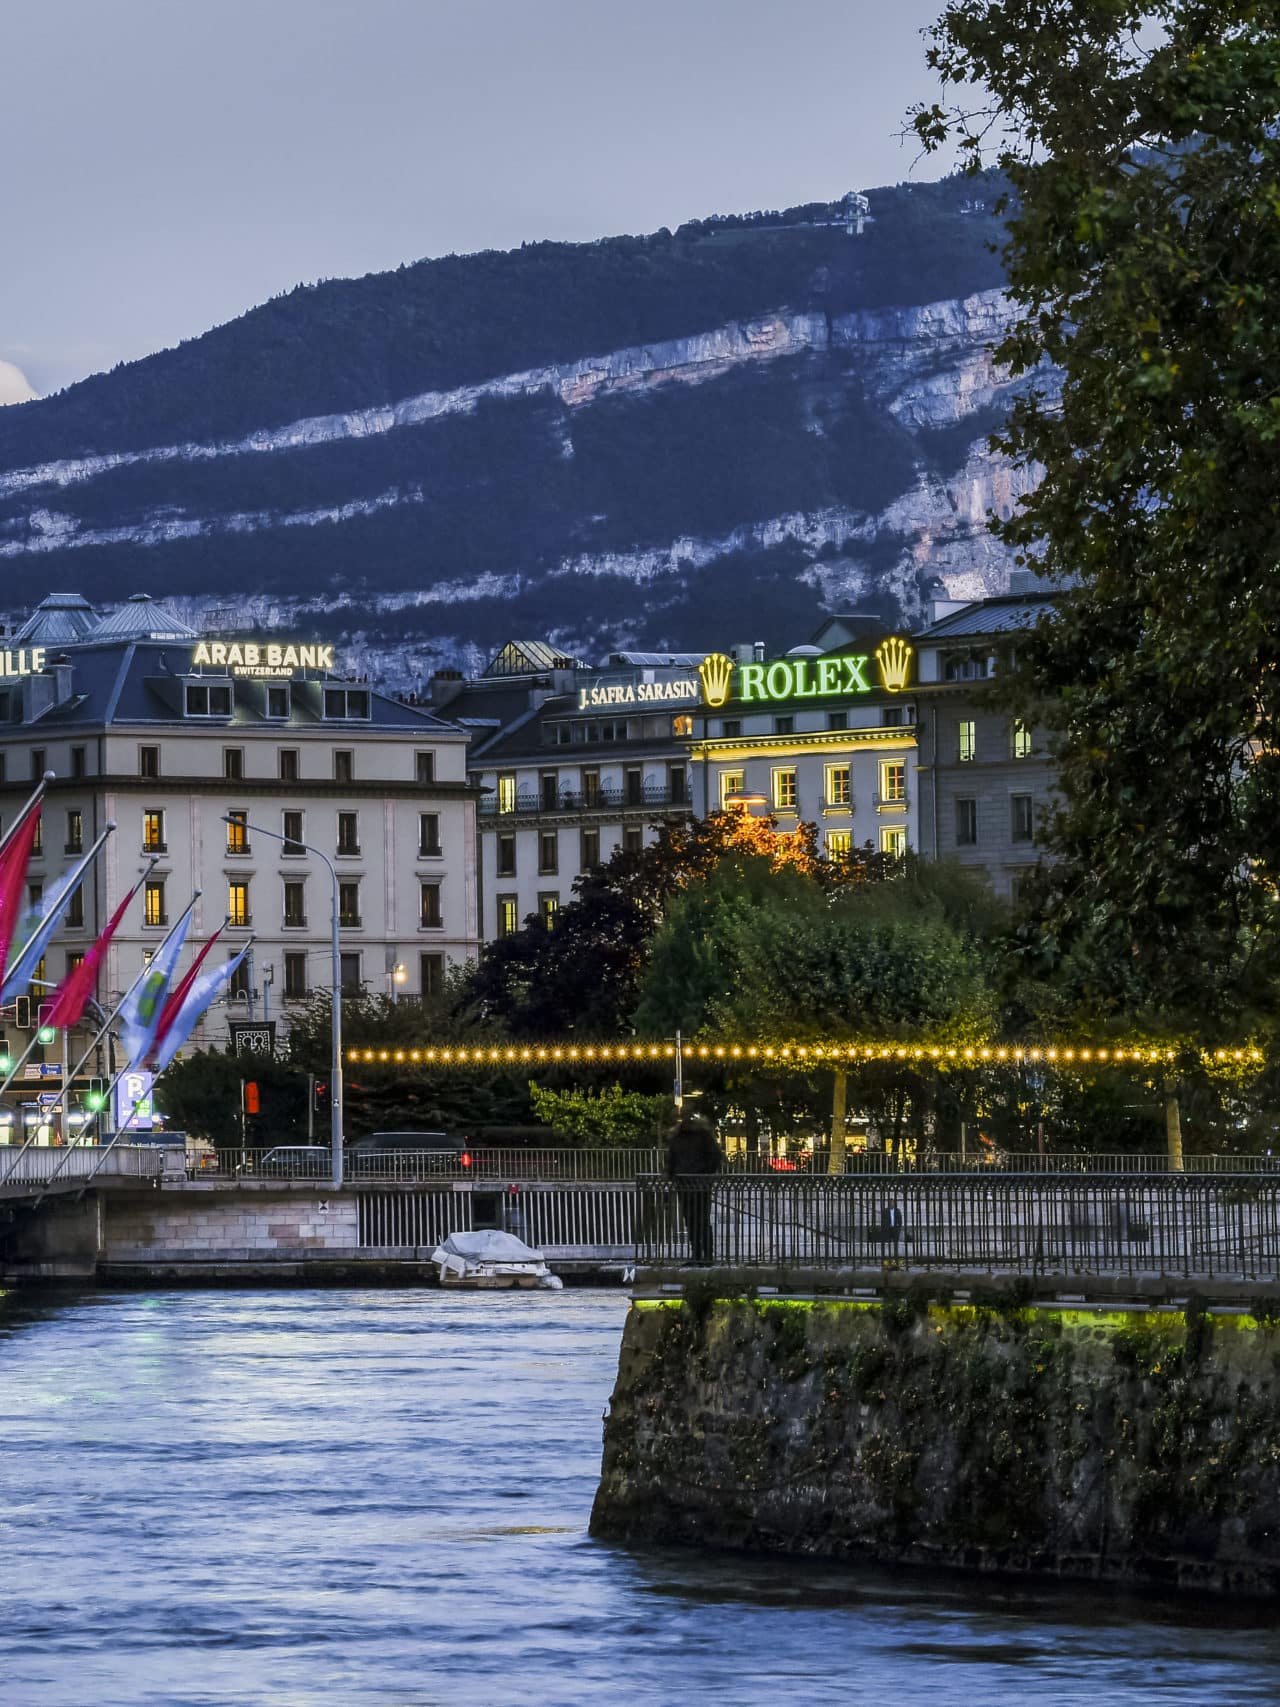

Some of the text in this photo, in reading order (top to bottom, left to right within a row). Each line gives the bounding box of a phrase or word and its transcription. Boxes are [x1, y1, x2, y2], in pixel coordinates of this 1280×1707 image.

[194, 643, 333, 668] ARAB BANK
[234, 666, 293, 676] SWITZERLAND
[739, 656, 871, 701] ROLEX
[578, 681, 698, 710] J. SAFRA SARASIN
